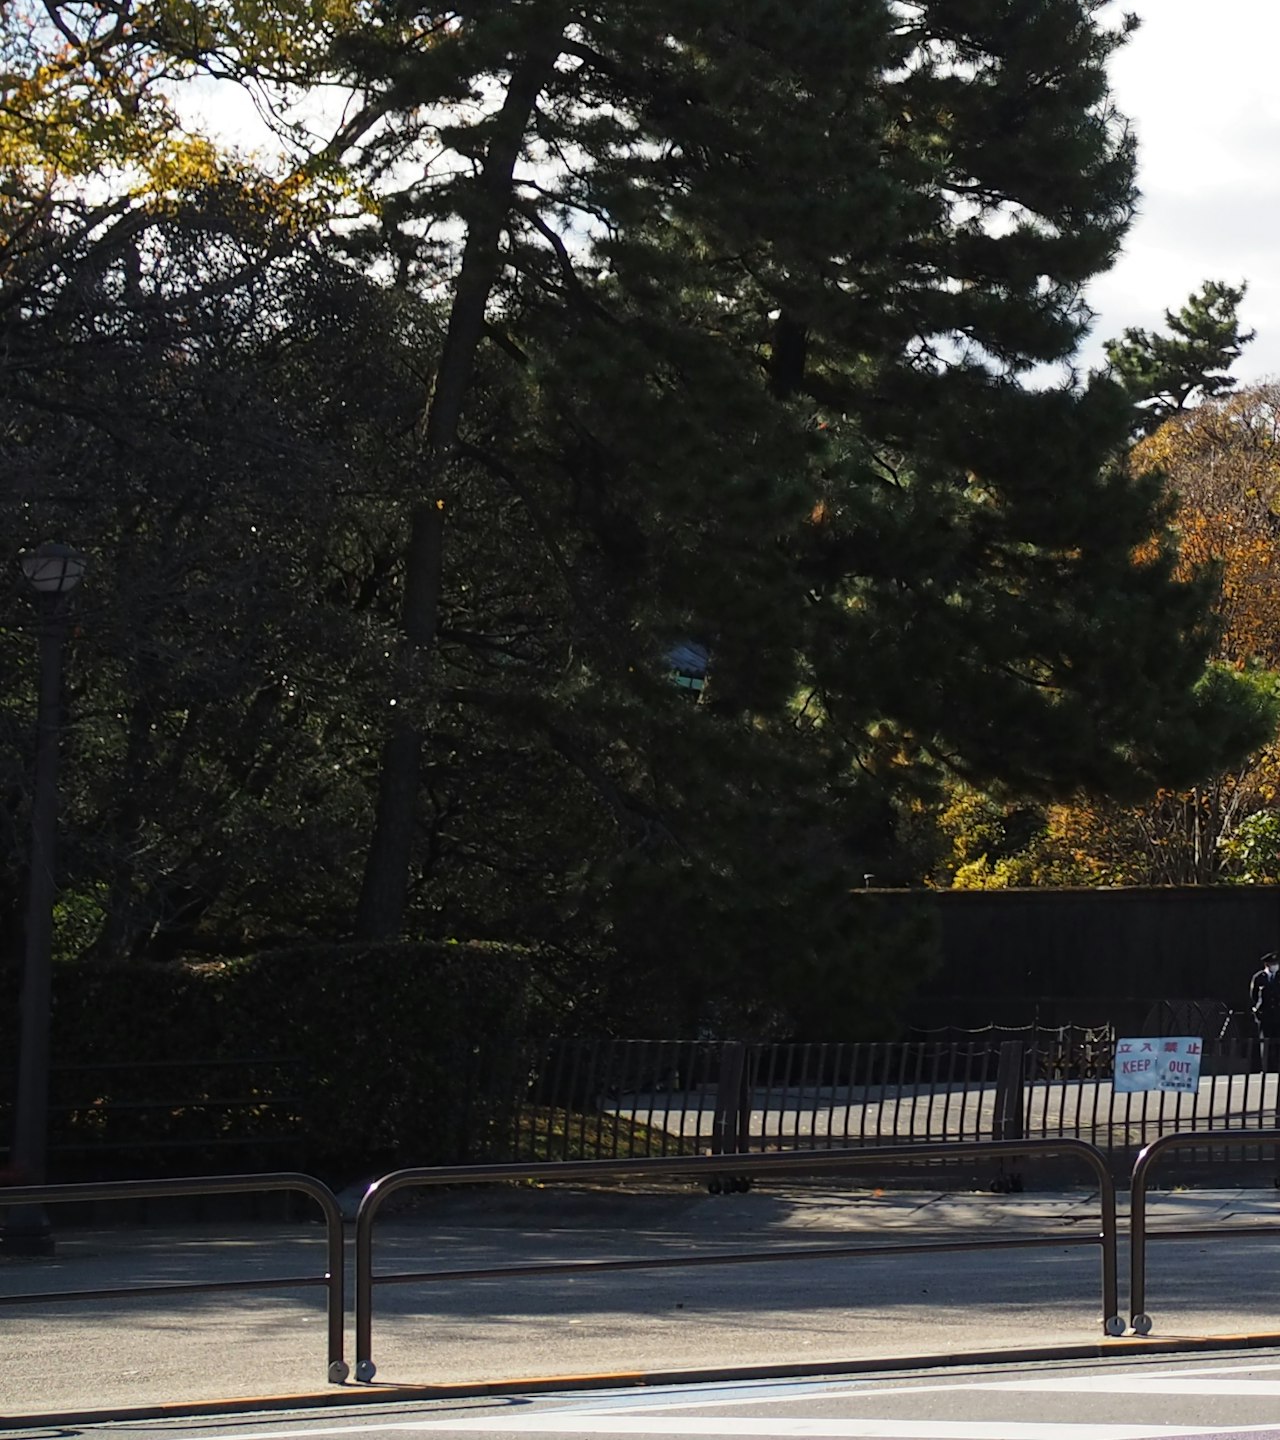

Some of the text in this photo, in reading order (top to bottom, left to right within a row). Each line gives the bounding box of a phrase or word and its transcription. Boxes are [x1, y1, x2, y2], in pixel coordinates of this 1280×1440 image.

[1118, 1041, 1201, 1055] 立入禁止
[1122, 1059, 1192, 1074] KEEP OUT
